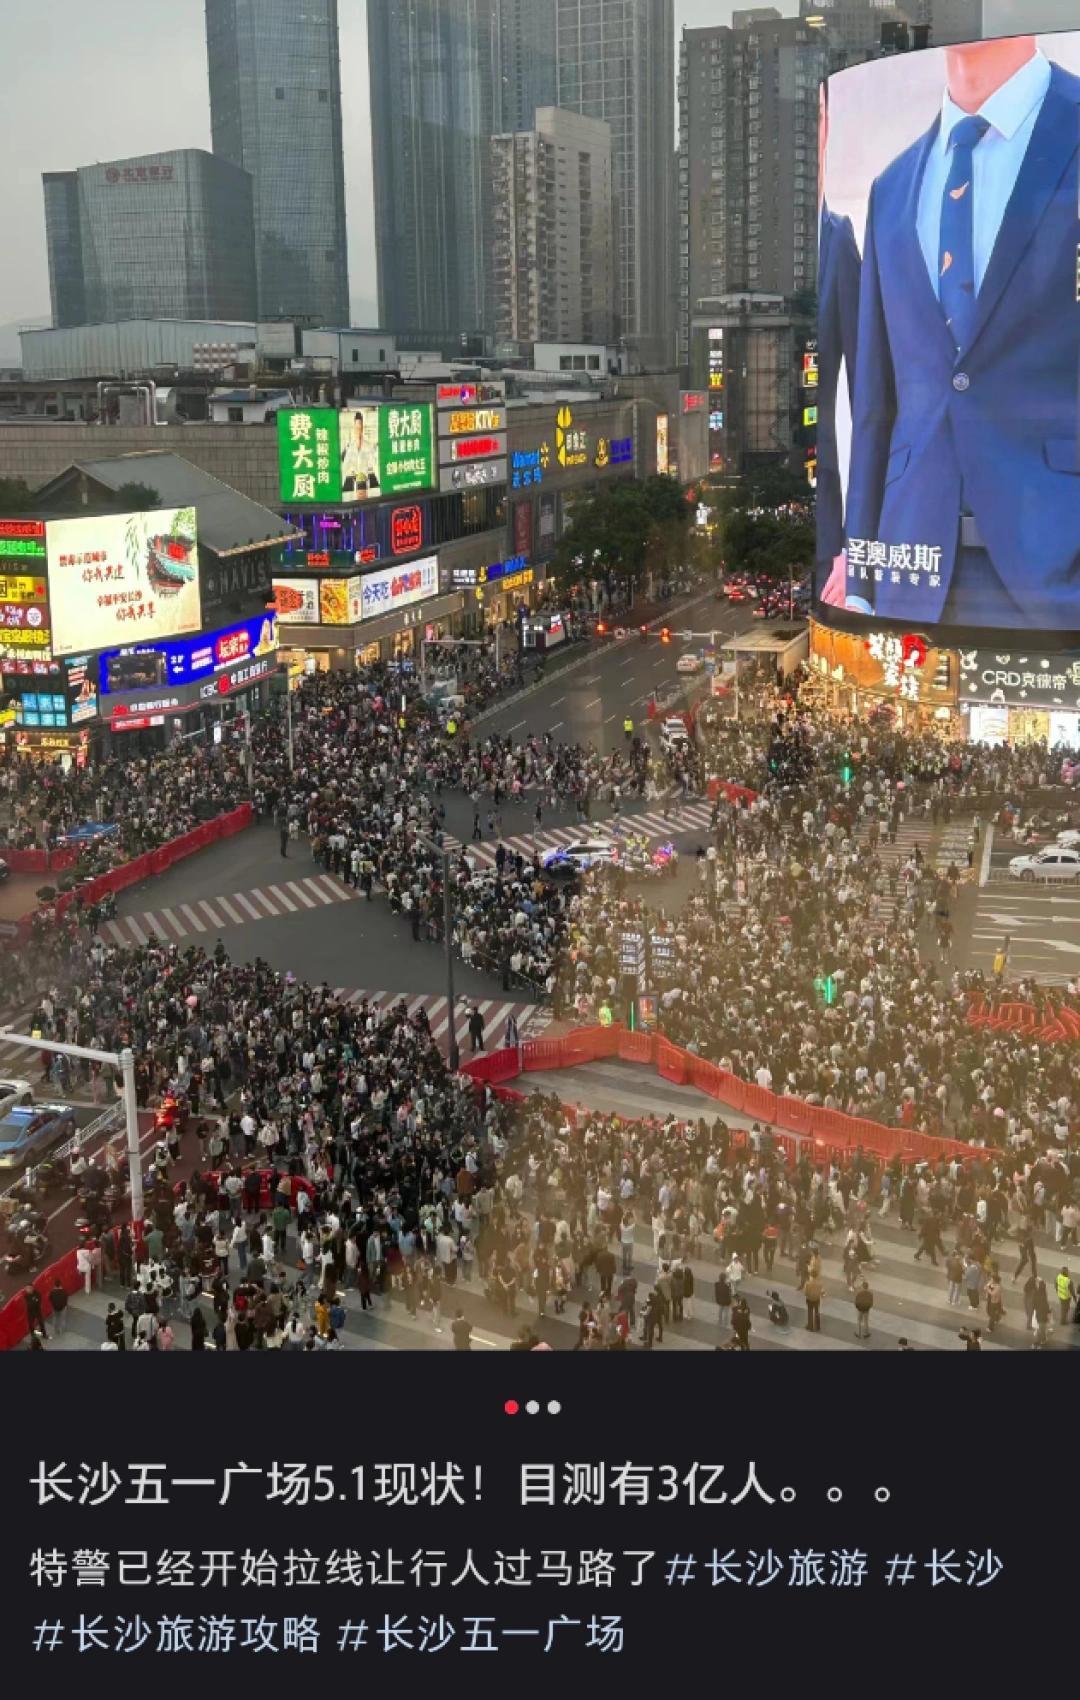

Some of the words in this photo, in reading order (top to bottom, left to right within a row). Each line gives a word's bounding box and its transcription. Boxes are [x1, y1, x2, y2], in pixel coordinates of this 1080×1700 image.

[288, 413, 316, 498] 费大厨
[848, 537, 942, 572] 圣澳威斯
